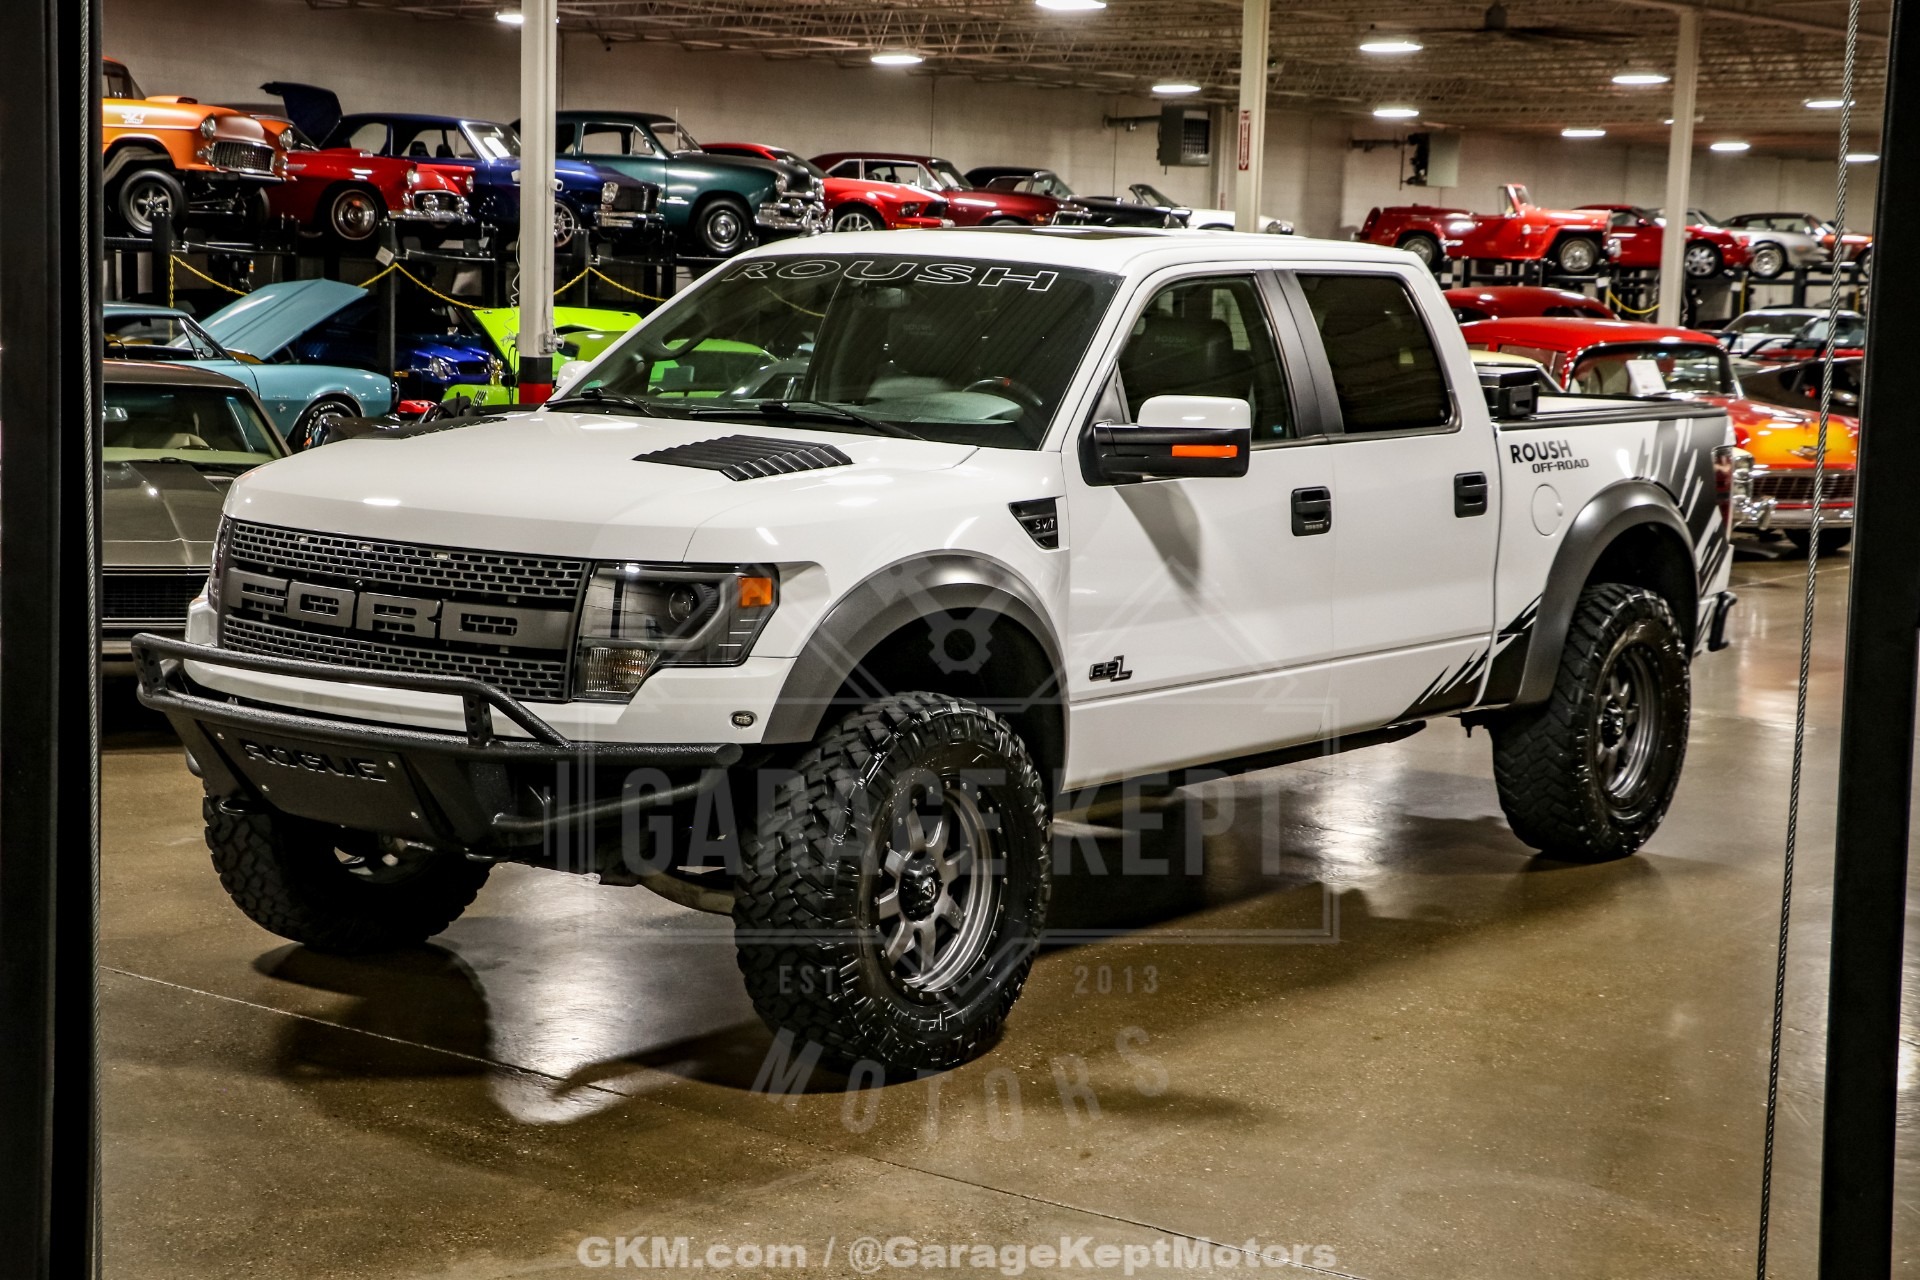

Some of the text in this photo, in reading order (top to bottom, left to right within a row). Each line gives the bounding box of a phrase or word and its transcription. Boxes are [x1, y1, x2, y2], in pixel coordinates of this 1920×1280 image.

[722, 260, 1059, 292] ROUSH
[1509, 440, 1573, 464] ROUSH
[1532, 458, 1590, 474] OFF-ROAD
[225, 566, 572, 649] FORD
[239, 738, 388, 783] ROGUE
